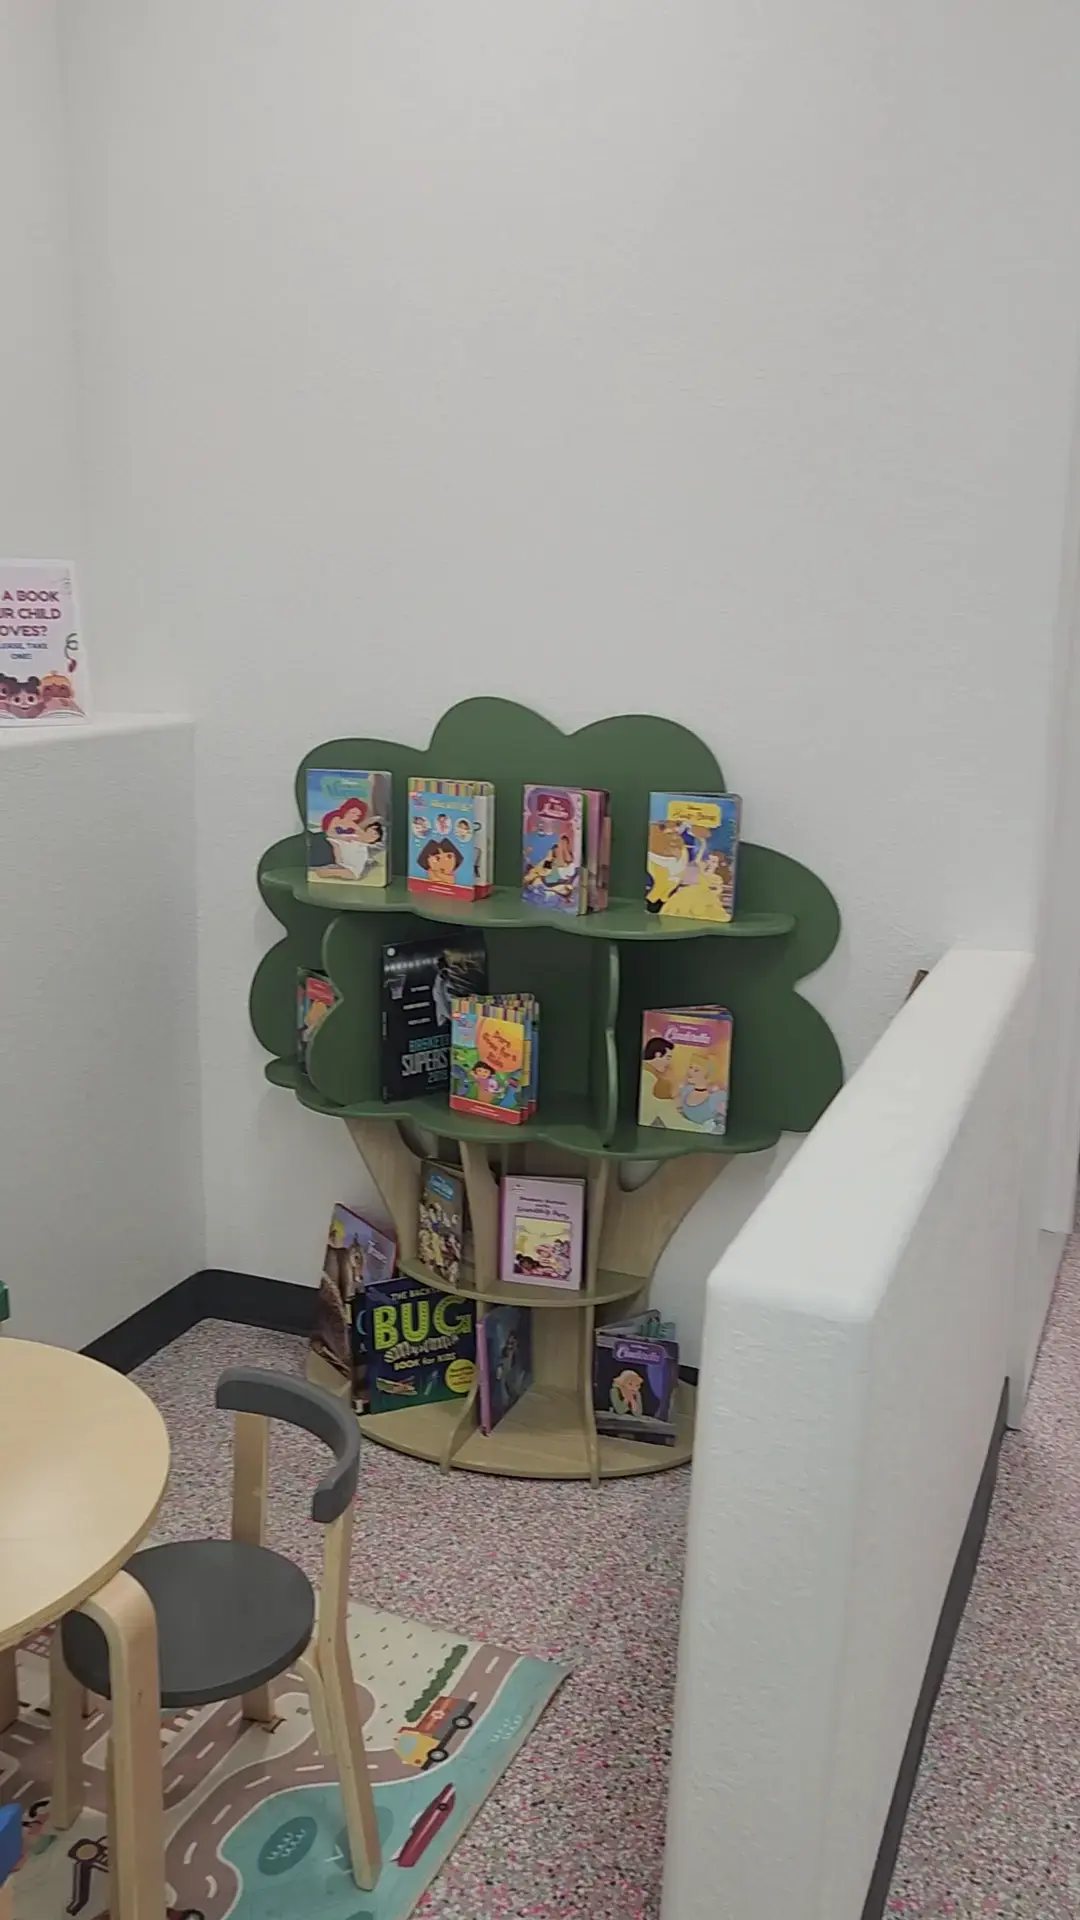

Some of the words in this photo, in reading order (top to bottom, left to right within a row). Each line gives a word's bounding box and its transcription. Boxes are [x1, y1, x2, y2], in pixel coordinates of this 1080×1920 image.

[2, 590, 13, 601] A
[16, 590, 60, 602] BOOK
[18, 608, 61, 619] CHILD
[373, 1296, 472, 1350] BUG
[394, 1359, 421, 1371] BOOK
[422, 1356, 436, 1366] for
[437, 1352, 457, 1364] KIDS
